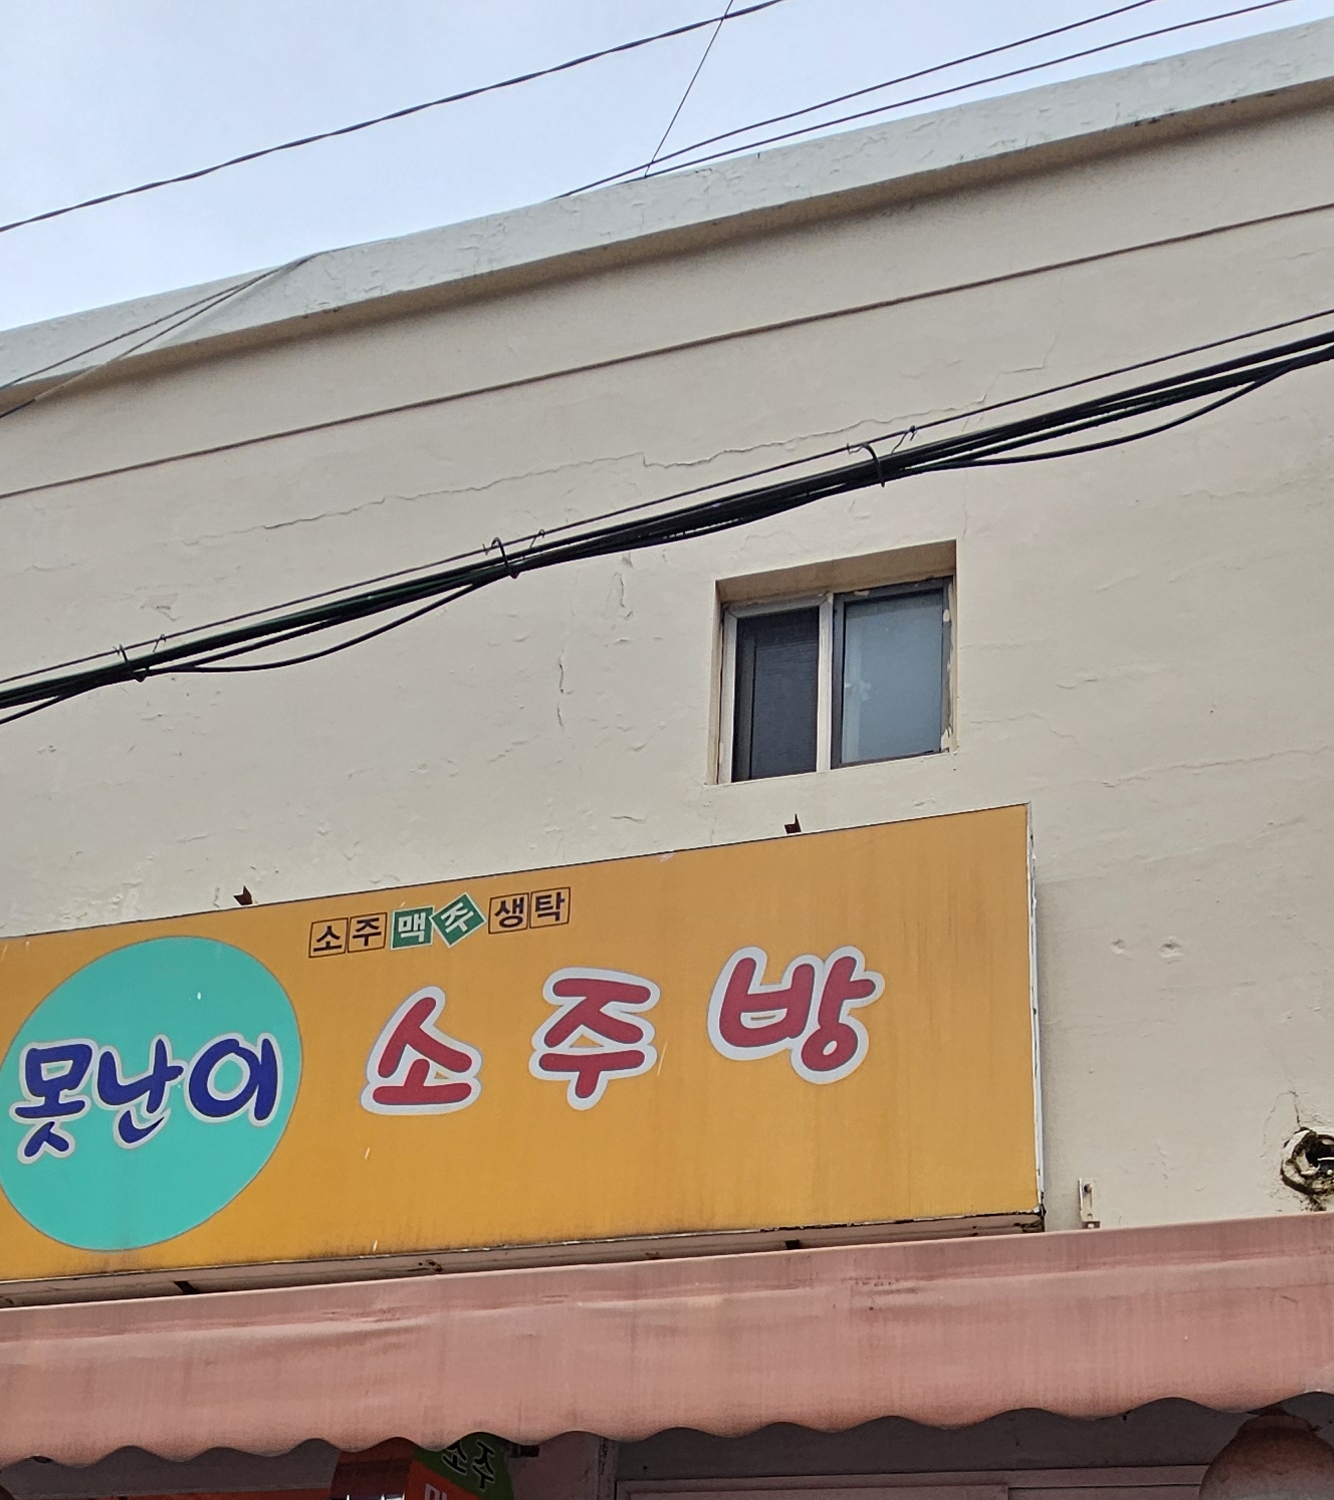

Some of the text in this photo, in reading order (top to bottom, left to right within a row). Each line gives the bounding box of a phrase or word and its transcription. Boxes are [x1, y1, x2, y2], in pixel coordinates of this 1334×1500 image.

[313, 891, 566, 952] 소주 맥주 생탁
[11, 1035, 281, 1162] 못난이
